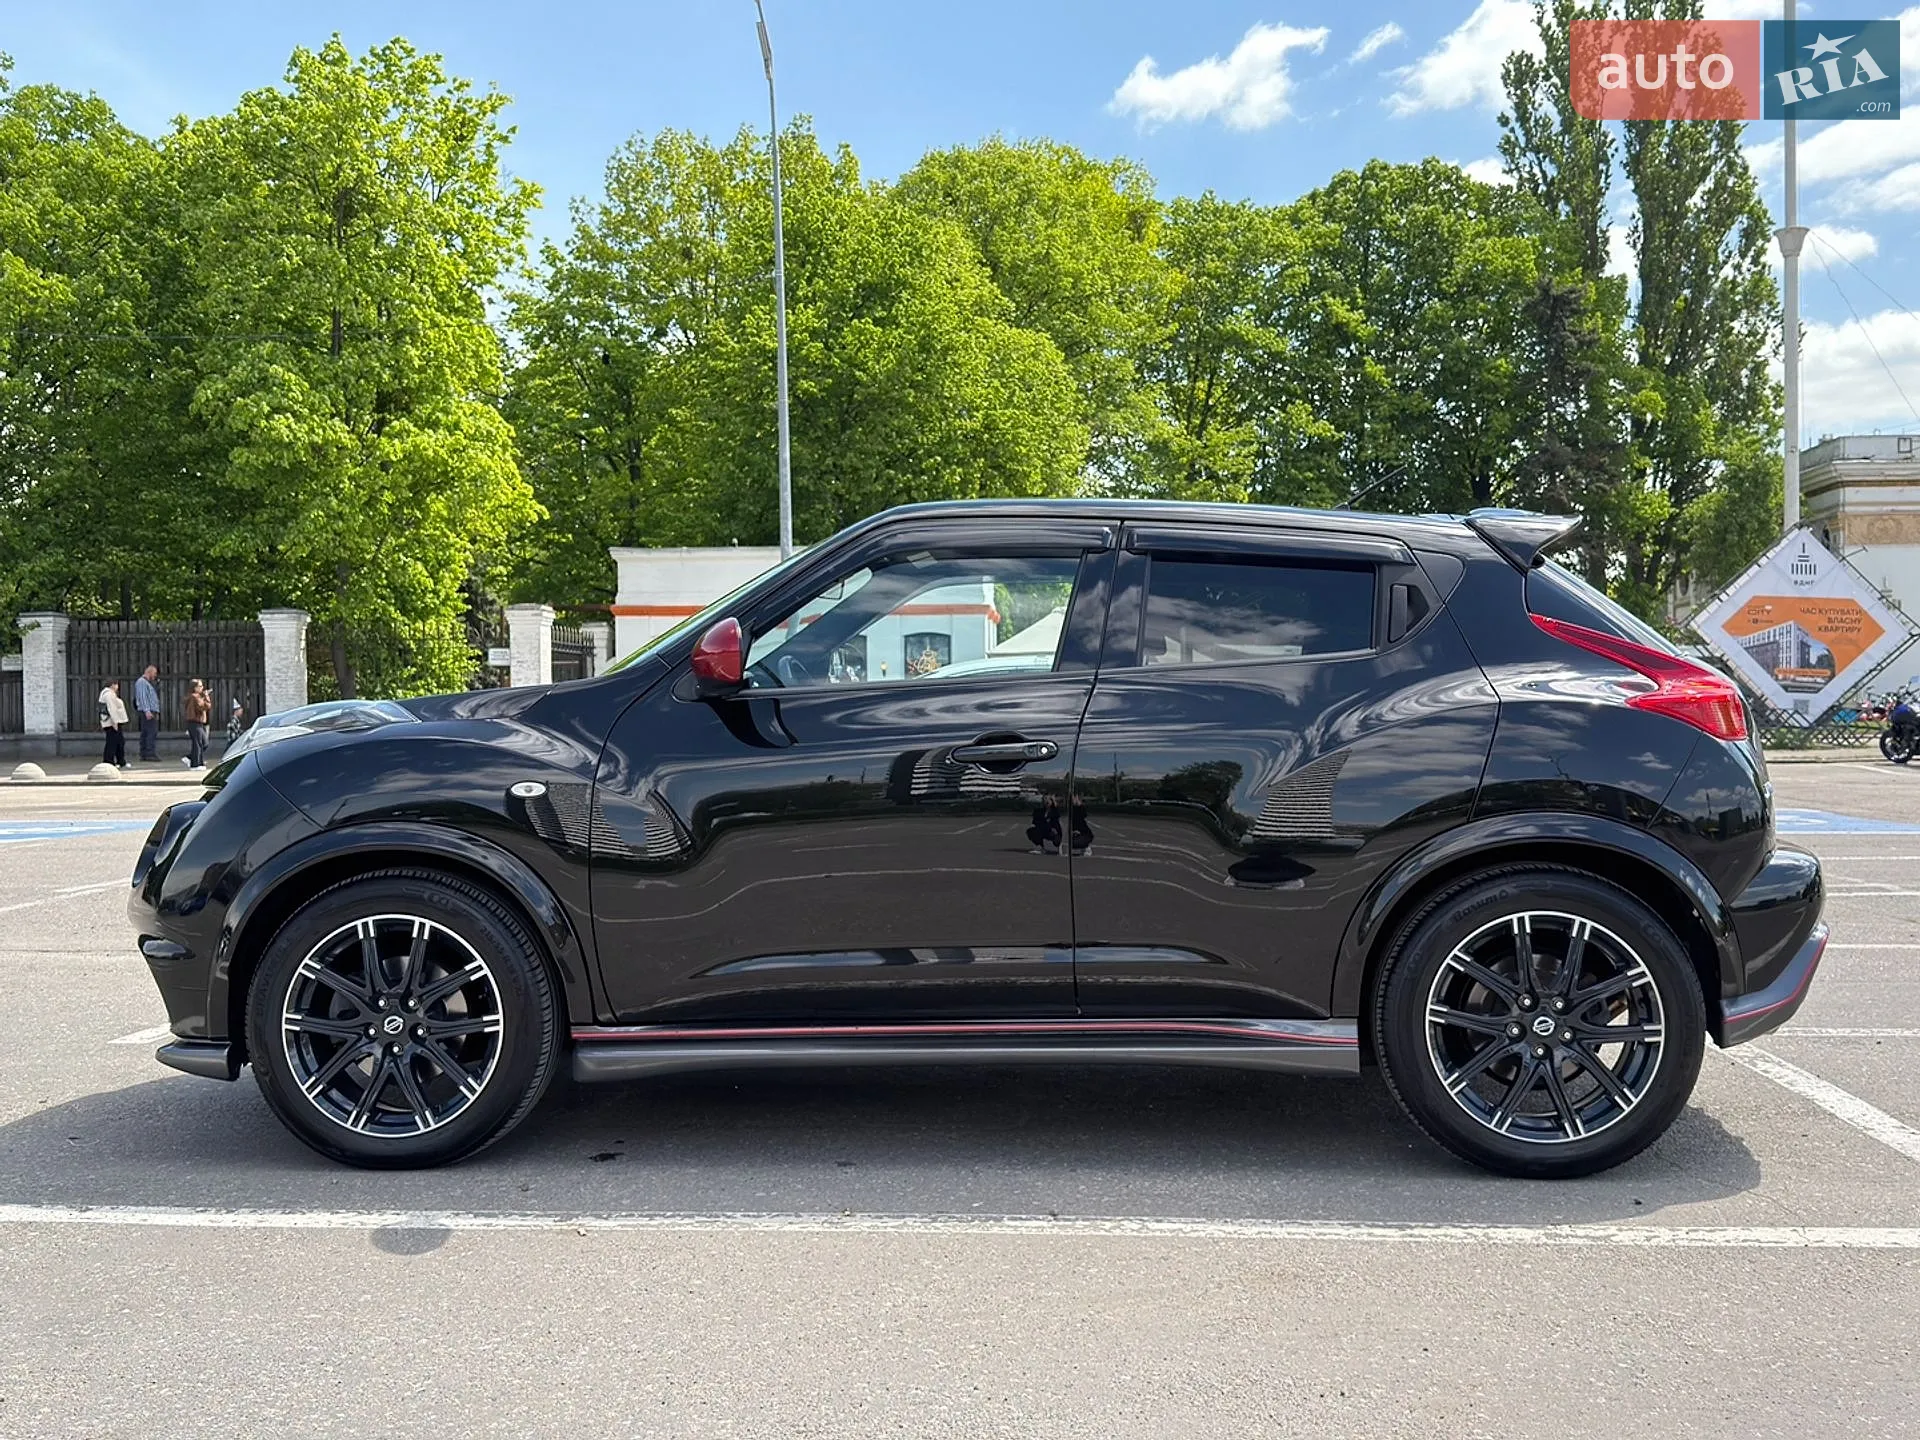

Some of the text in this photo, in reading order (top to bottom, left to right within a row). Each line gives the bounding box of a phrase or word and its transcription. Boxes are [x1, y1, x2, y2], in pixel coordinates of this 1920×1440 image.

[1800, 607, 1862, 616] ЧАС КУПУВАТИ
[1827, 616, 1863, 625] ВЛАСНУ
[1817, 625, 1862, 633] КВАРТИРУ
